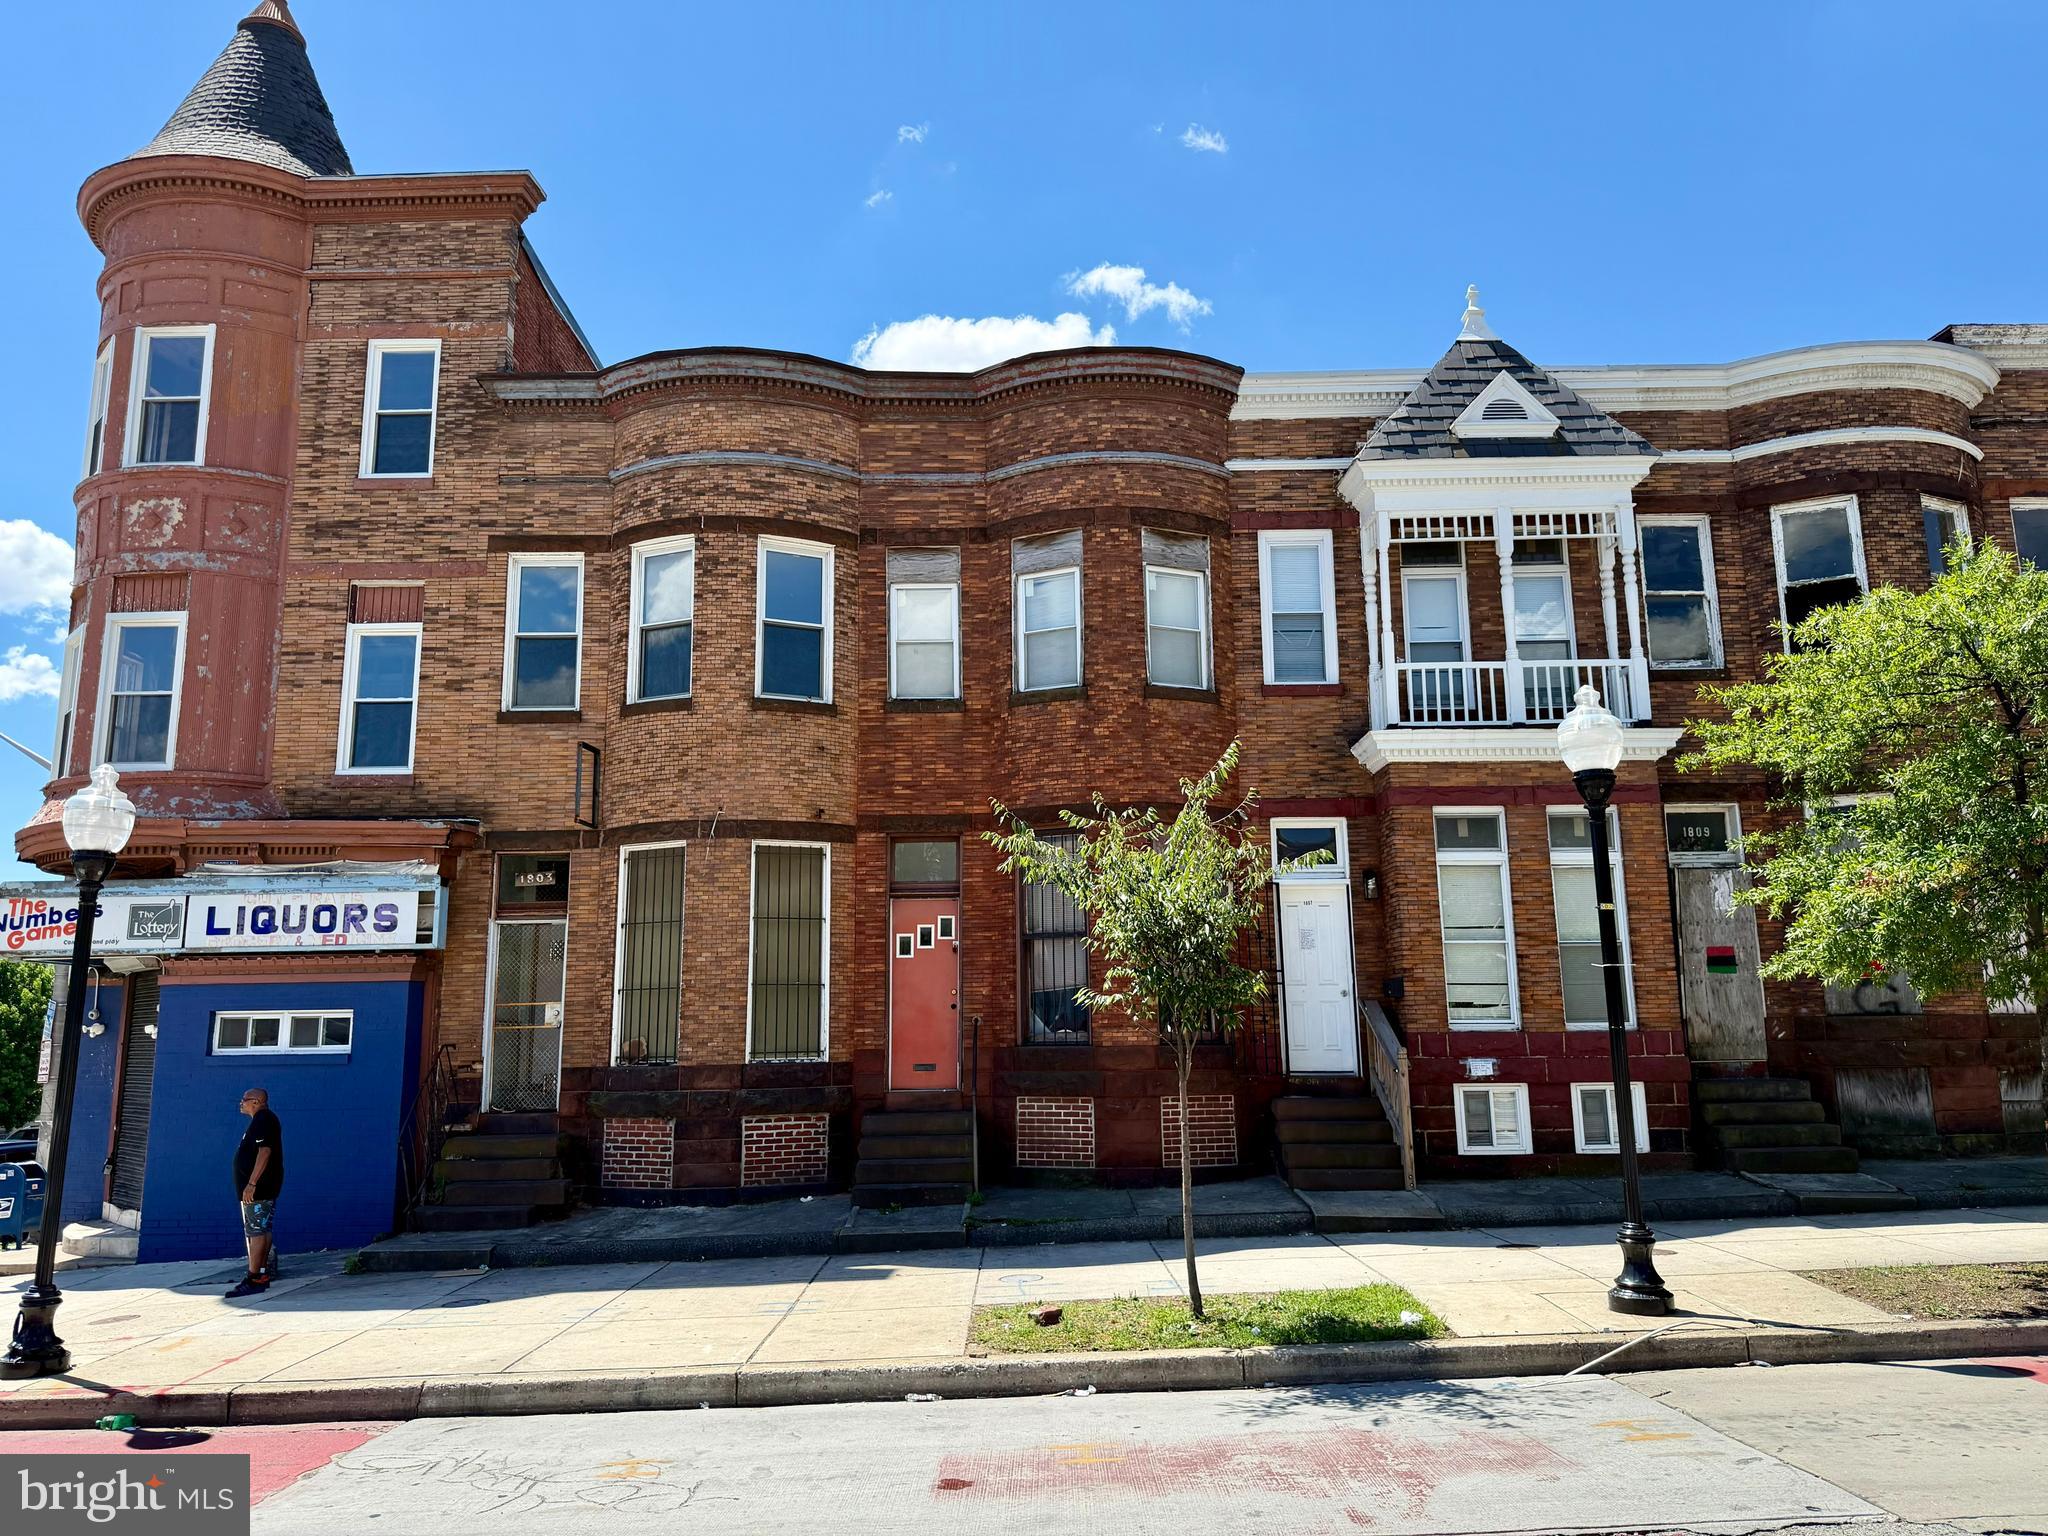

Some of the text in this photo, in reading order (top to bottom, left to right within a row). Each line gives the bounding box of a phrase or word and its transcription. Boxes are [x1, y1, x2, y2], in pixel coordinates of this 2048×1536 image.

[1682, 827, 1710, 838] 1809
[8, 897, 48, 917] The
[138, 910, 155, 919] The
[0, 904, 104, 932] Numbes
[205, 903, 399, 936] LIQUORS
[133, 921, 178, 937] Lottery
